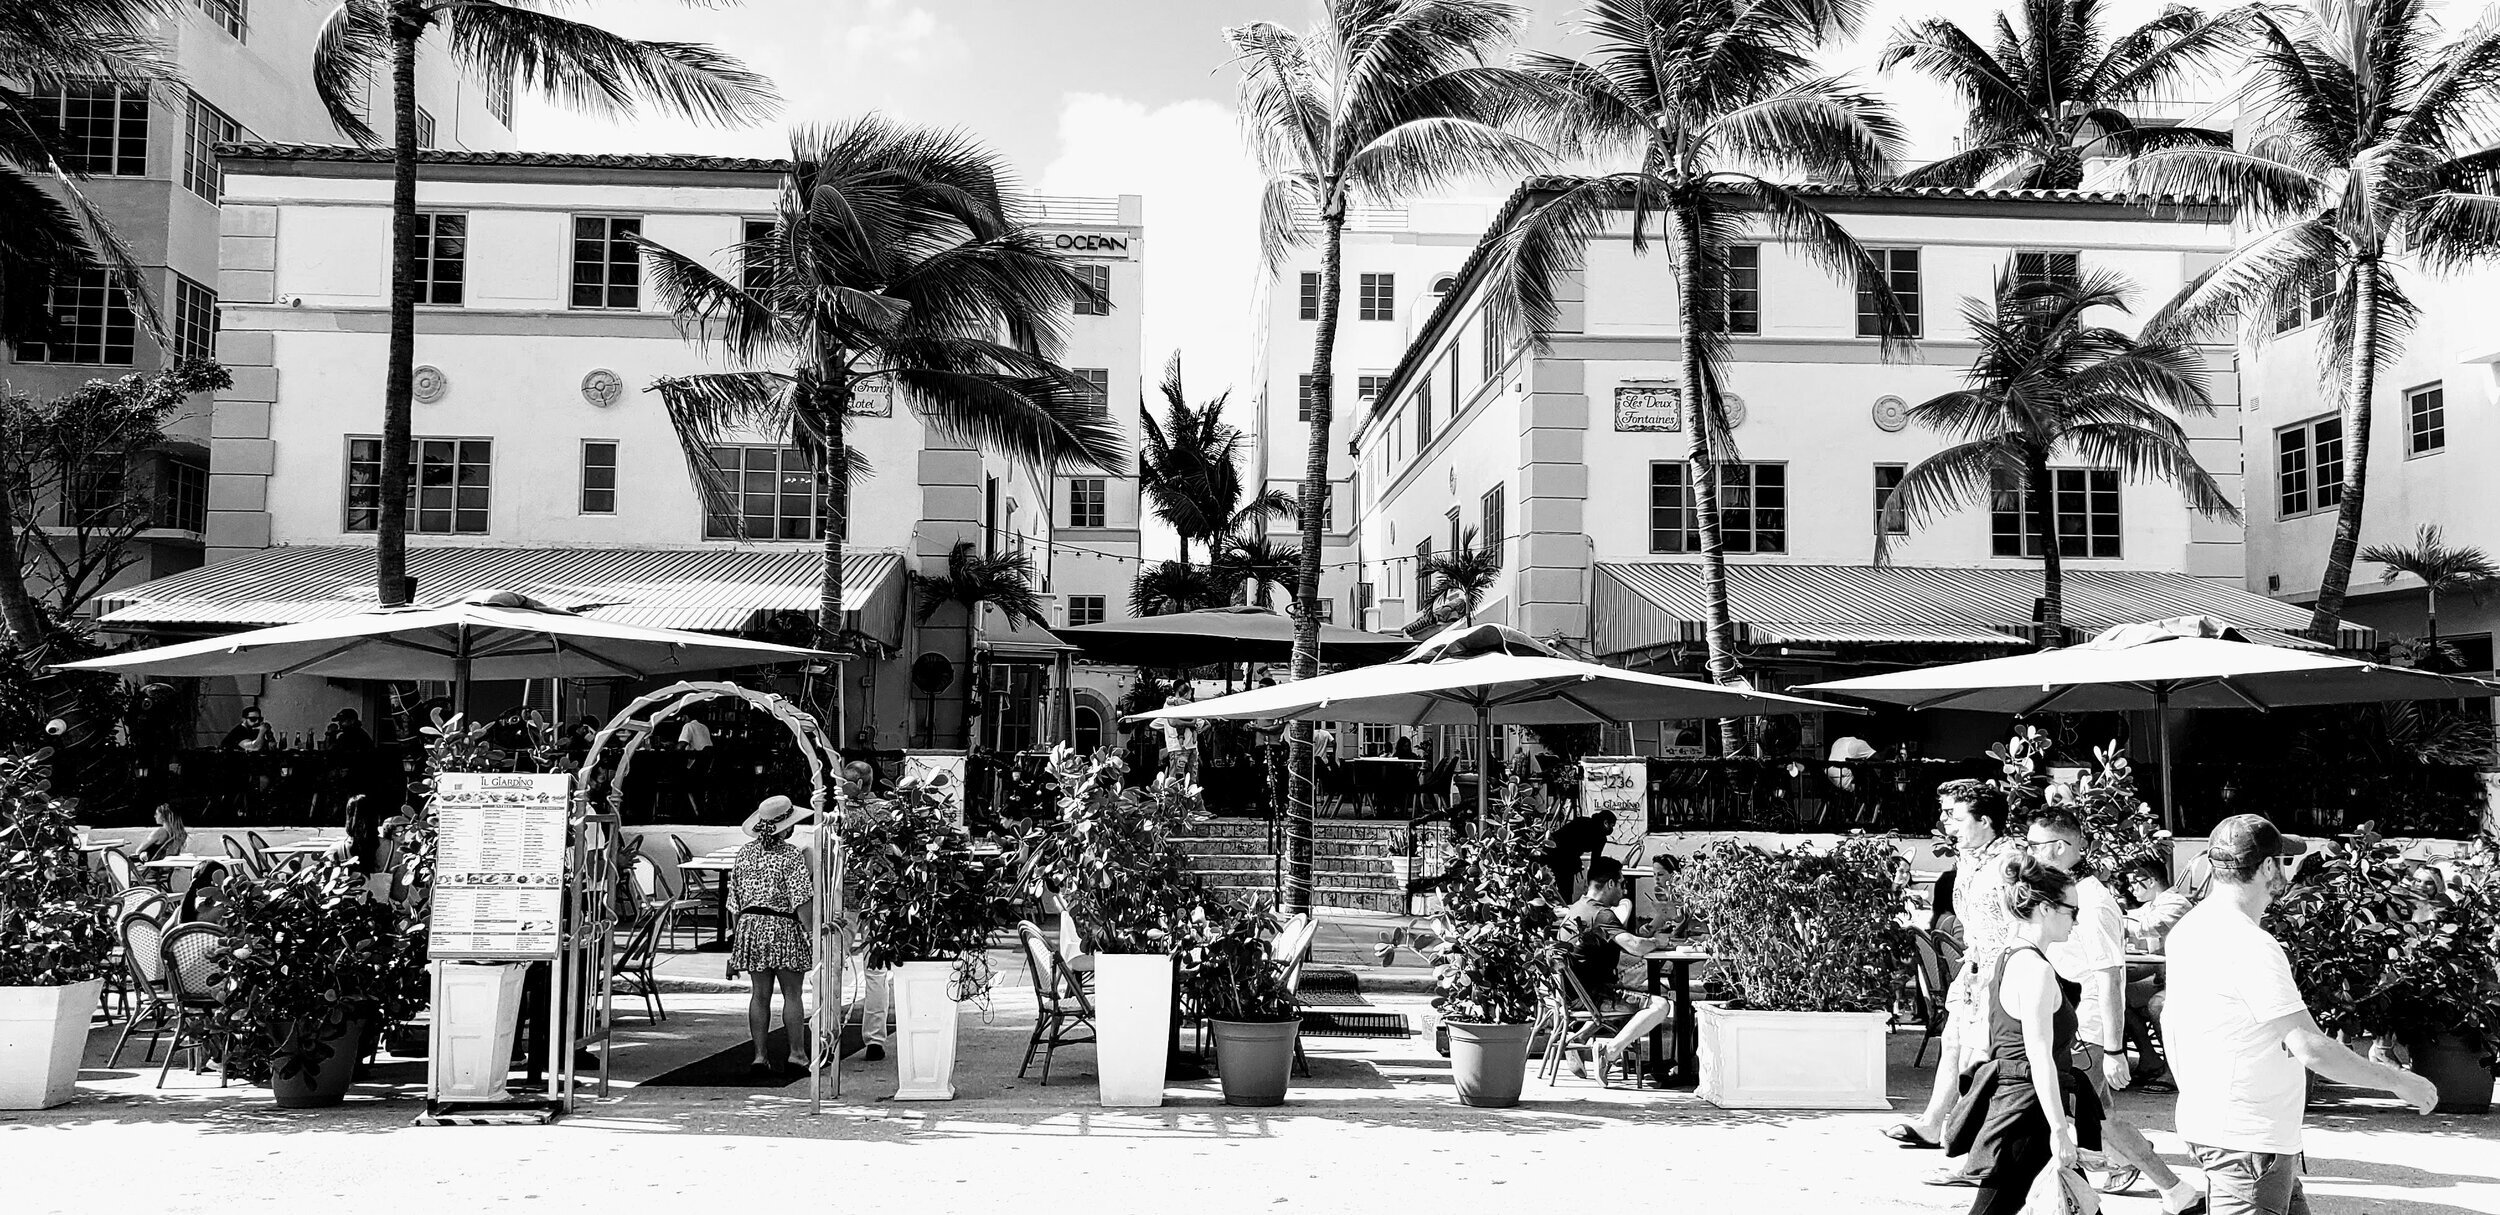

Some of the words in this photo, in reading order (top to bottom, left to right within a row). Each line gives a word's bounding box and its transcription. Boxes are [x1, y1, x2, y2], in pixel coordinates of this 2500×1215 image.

[1055, 234, 1127, 251] OCEAN
[1622, 395, 1643, 409] Les
[1643, 395, 1672, 408] Deux
[1621, 411, 1675, 424] Fontaines
[481, 776, 489, 786] IL
[491, 776, 533, 787] GIARDINO
[1603, 775, 1634, 789] 1236
[1594, 799, 1601, 808] IL
[1603, 799, 1640, 809] GIARDINO
